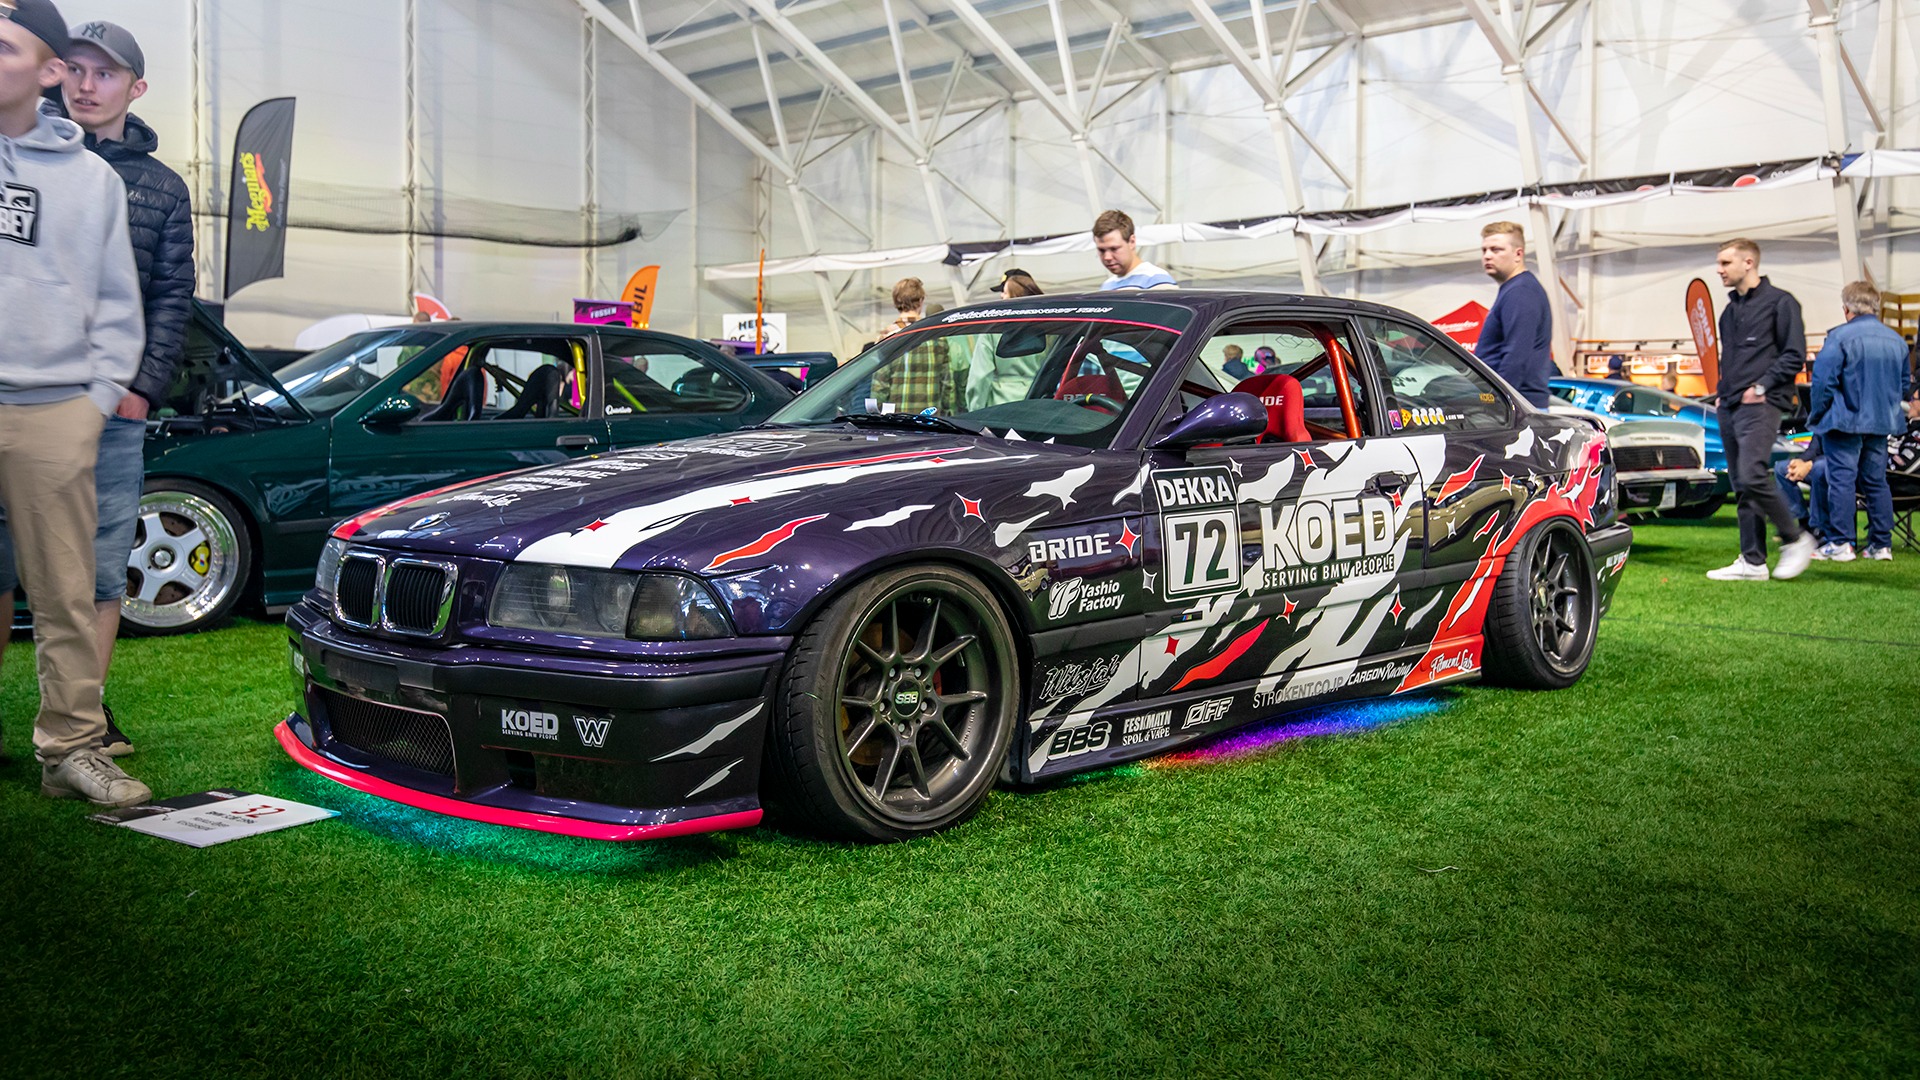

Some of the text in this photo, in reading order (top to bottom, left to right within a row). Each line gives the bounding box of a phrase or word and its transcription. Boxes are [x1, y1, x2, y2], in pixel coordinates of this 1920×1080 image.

[739, 318, 768, 330] HEL
[1156, 475, 1235, 507] DEKRA
[1027, 532, 1112, 563] BRIDE
[1259, 497, 1395, 570] KOED
[1174, 519, 1230, 585] 72
[1264, 554, 1395, 589] SERVING BMW PEOPLE
[1078, 593, 1125, 613] Factory
[1080, 579, 1120, 599] Yashio
[1347, 666, 1386, 686] CARGON
[501, 709, 559, 735] KOED
[1151, 727, 1170, 740] VAPE
[1048, 721, 1113, 760] BBS
